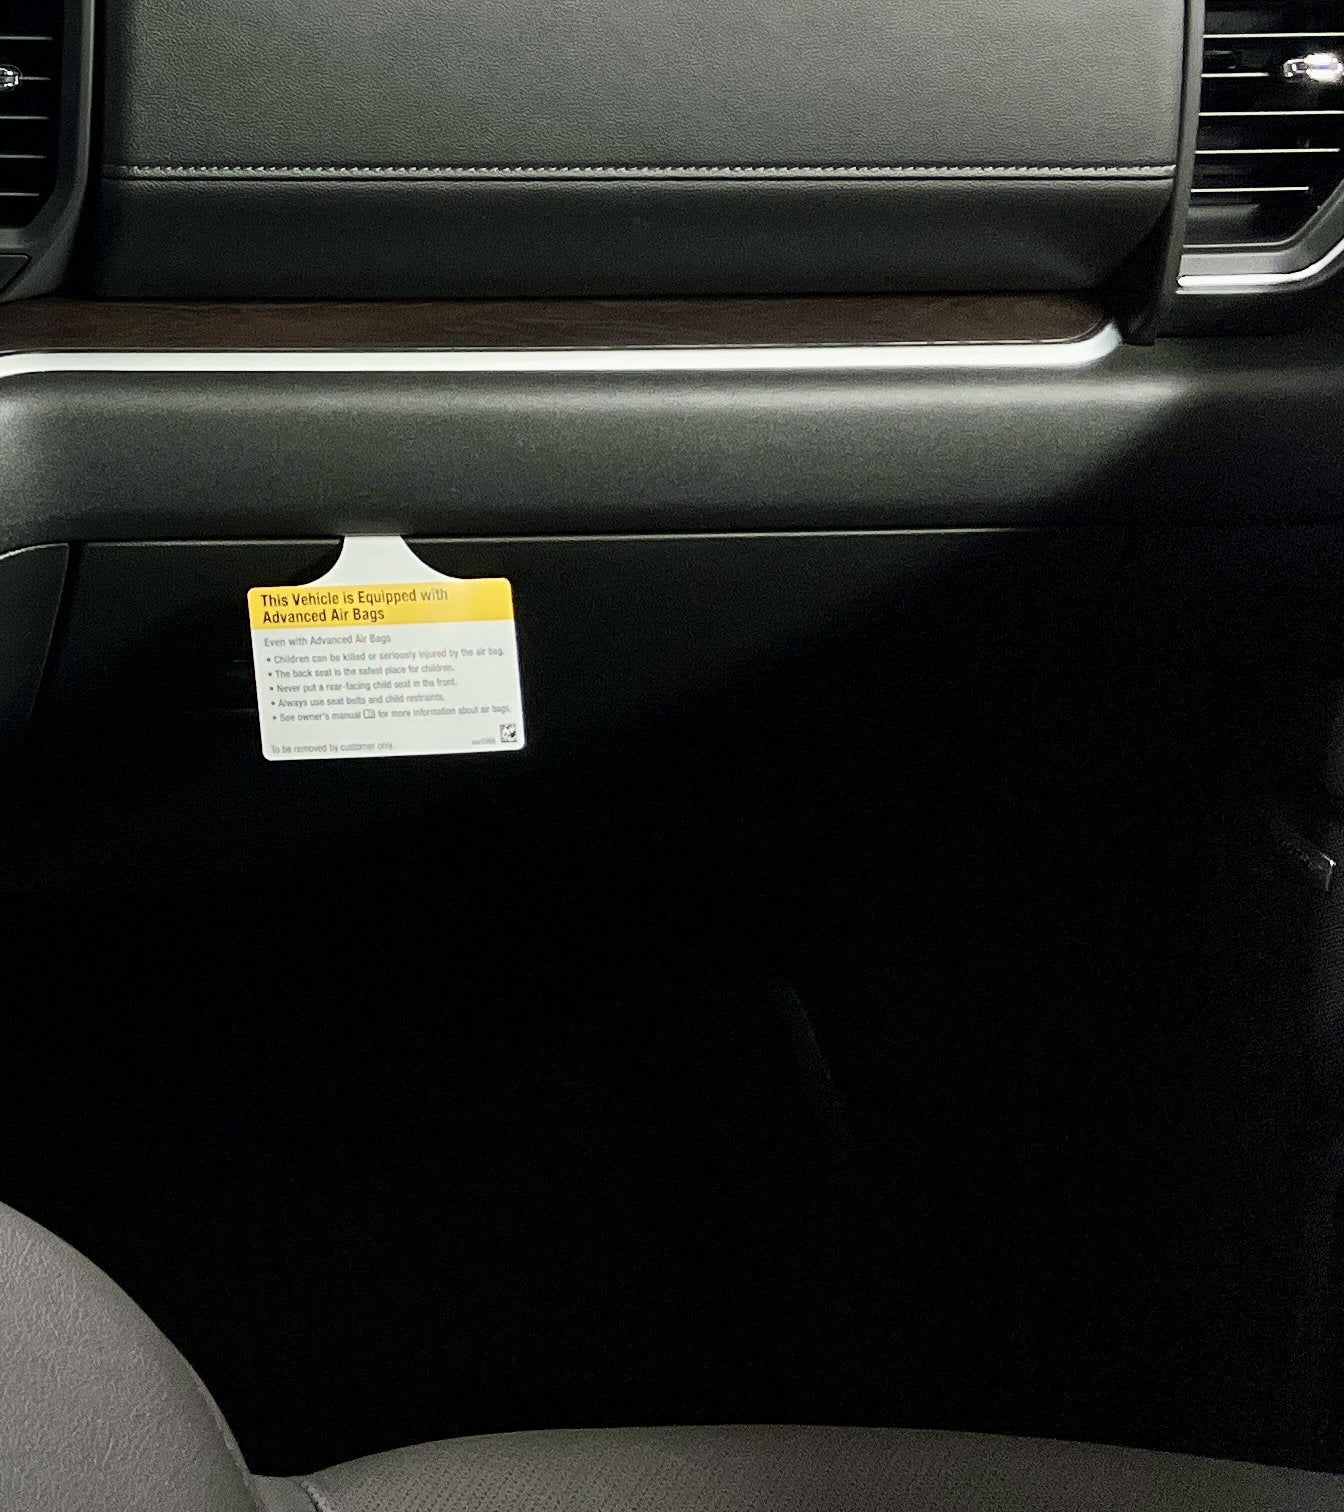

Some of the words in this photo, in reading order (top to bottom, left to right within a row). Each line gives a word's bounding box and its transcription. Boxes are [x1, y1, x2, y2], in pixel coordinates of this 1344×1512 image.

[261, 594, 288, 607] This
[292, 593, 339, 606] Vehicle
[343, 592, 355, 604] is
[359, 590, 417, 606] Equipped
[421, 588, 448, 602] with
[263, 610, 326, 624] Advanced
[331, 608, 349, 621] Air
[353, 608, 385, 622] Bags
[264, 637, 286, 647] Even
[288, 637, 308, 646] with
[310, 635, 353, 646] Advanced
[355, 635, 367, 644] Air
[370, 634, 391, 645] Bags
[274, 654, 310, 664] Children
[312, 654, 328, 663] can
[330, 652, 341, 662] be
[368, 652, 377, 661] or
[379, 650, 416, 663] seriously
[419, 649, 447, 661] injured
[449, 648, 460, 660] by
[275, 669, 291, 678] The
[292, 667, 313, 677] back
[315, 668, 333, 677] seat
[344, 667, 357, 676] the
[385, 664, 406, 677] place
[408, 664, 419, 673] for
[277, 683, 301, 693] Never
[303, 682, 317, 693] put
[373, 679, 392, 690] child
[394, 680, 411, 689] seat
[278, 697, 308, 709] Always
[310, 699, 325, 707] use
[327, 697, 344, 706] seat
[368, 695, 384, 704] and
[386, 694, 404, 704] child
[271, 744, 284, 754] To
[329, 742, 338, 753] by
